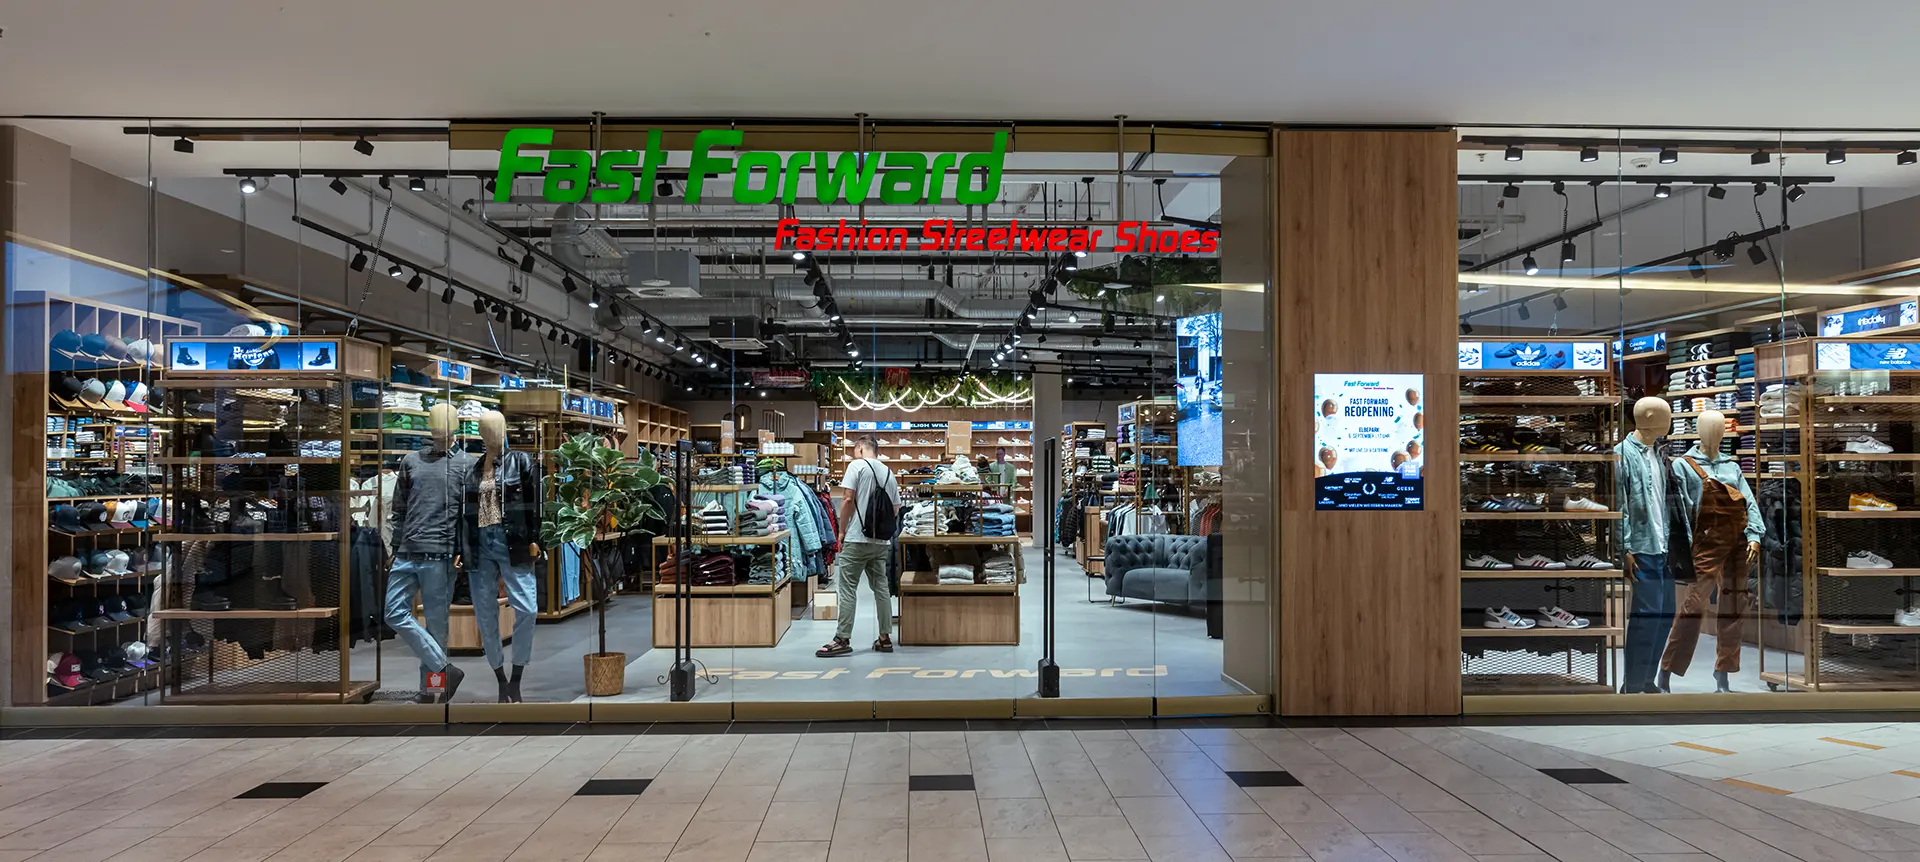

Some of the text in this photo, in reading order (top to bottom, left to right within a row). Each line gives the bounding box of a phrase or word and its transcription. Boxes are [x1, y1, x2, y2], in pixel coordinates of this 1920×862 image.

[493, 128, 1009, 205] Fast Forward
[774, 219, 1220, 253] Fashion Streetwear Shoes
[233, 348, 275, 360] Martens
[1344, 406, 1394, 417] REOPENING
[695, 667, 850, 680] Fast
